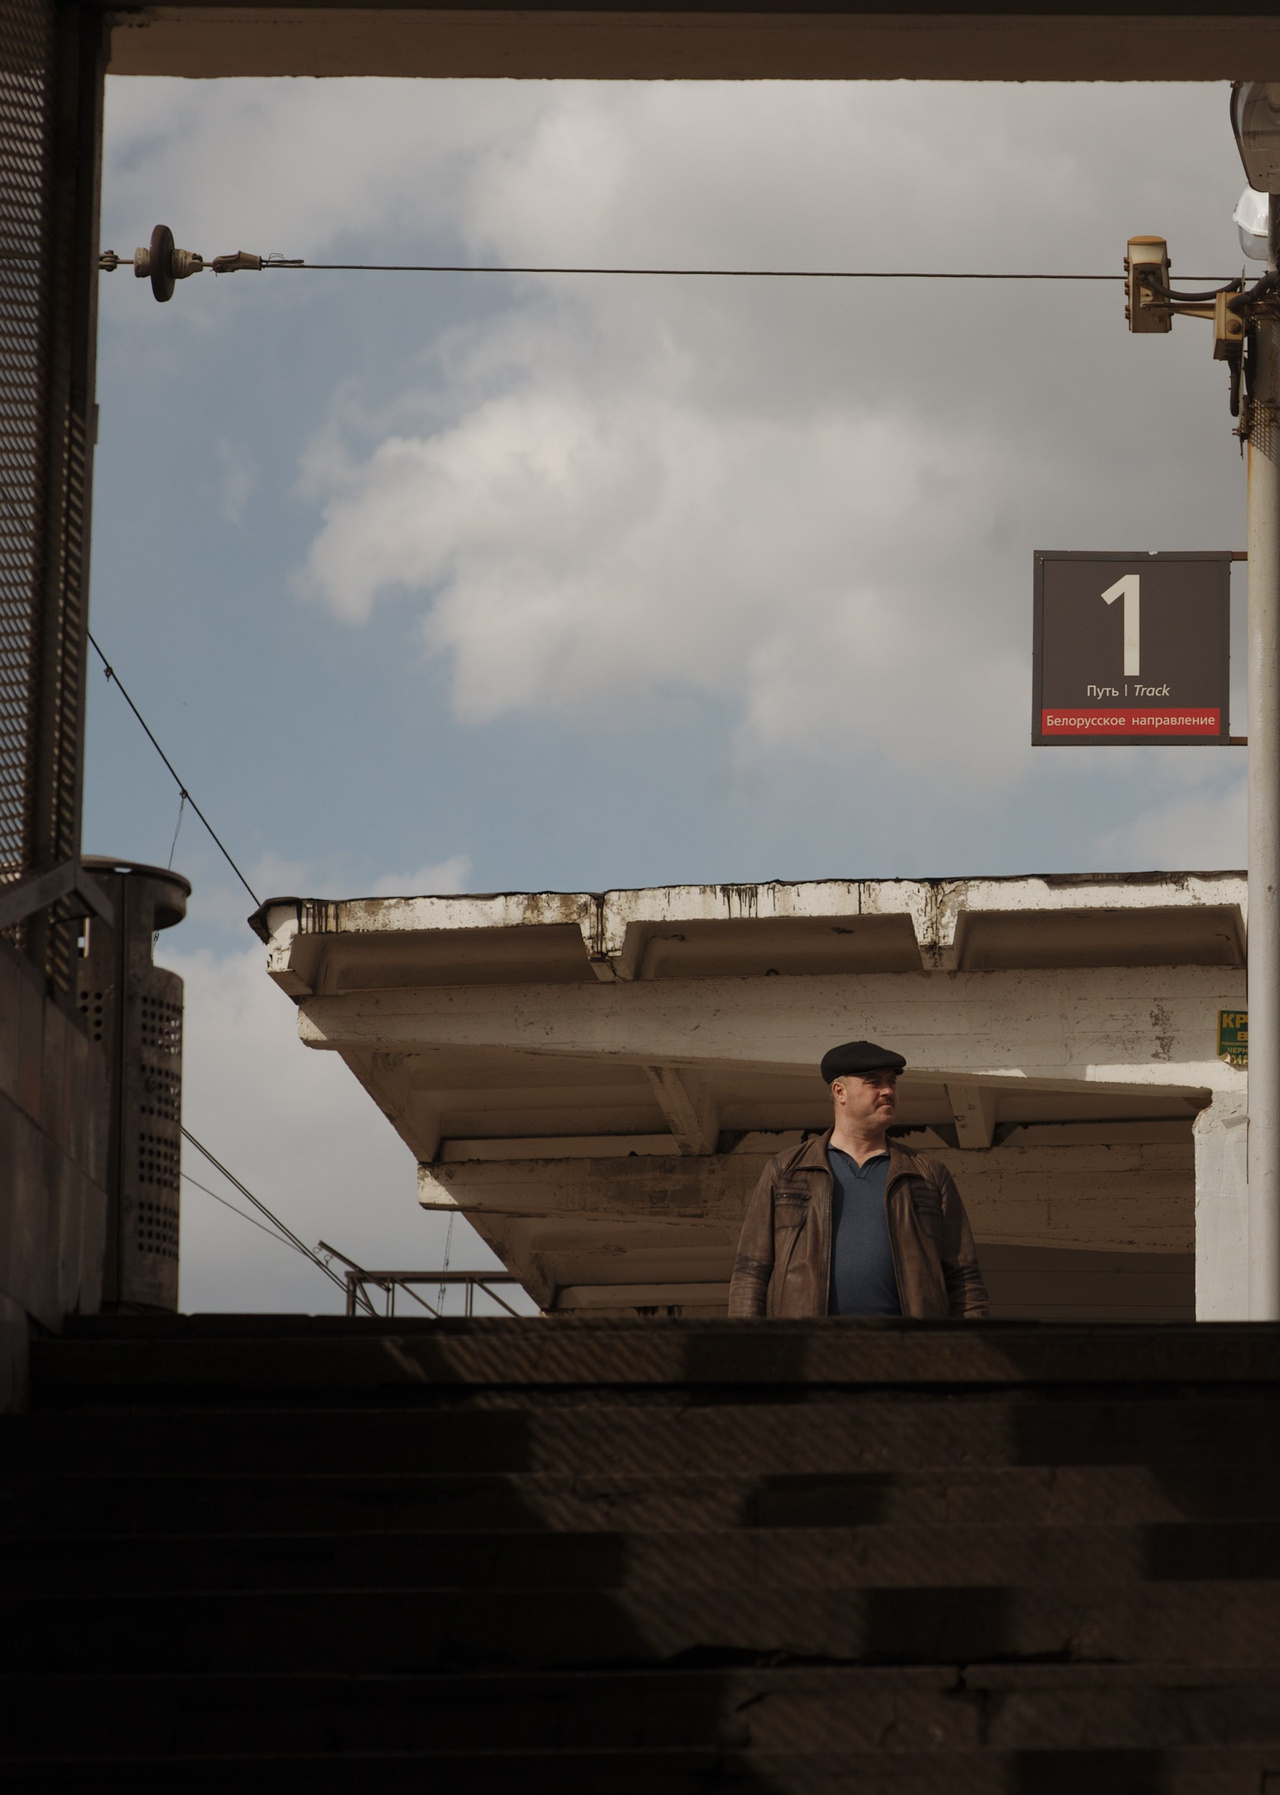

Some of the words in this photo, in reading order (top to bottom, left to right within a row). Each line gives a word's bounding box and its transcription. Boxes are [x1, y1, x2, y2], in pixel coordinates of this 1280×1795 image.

[1100, 574, 1140, 676] 1
[1086, 684, 1120, 699] Путь
[1134, 684, 1170, 697] Track
[1046, 715, 1126, 729] Белорусское
[1131, 716, 1216, 729] направление
